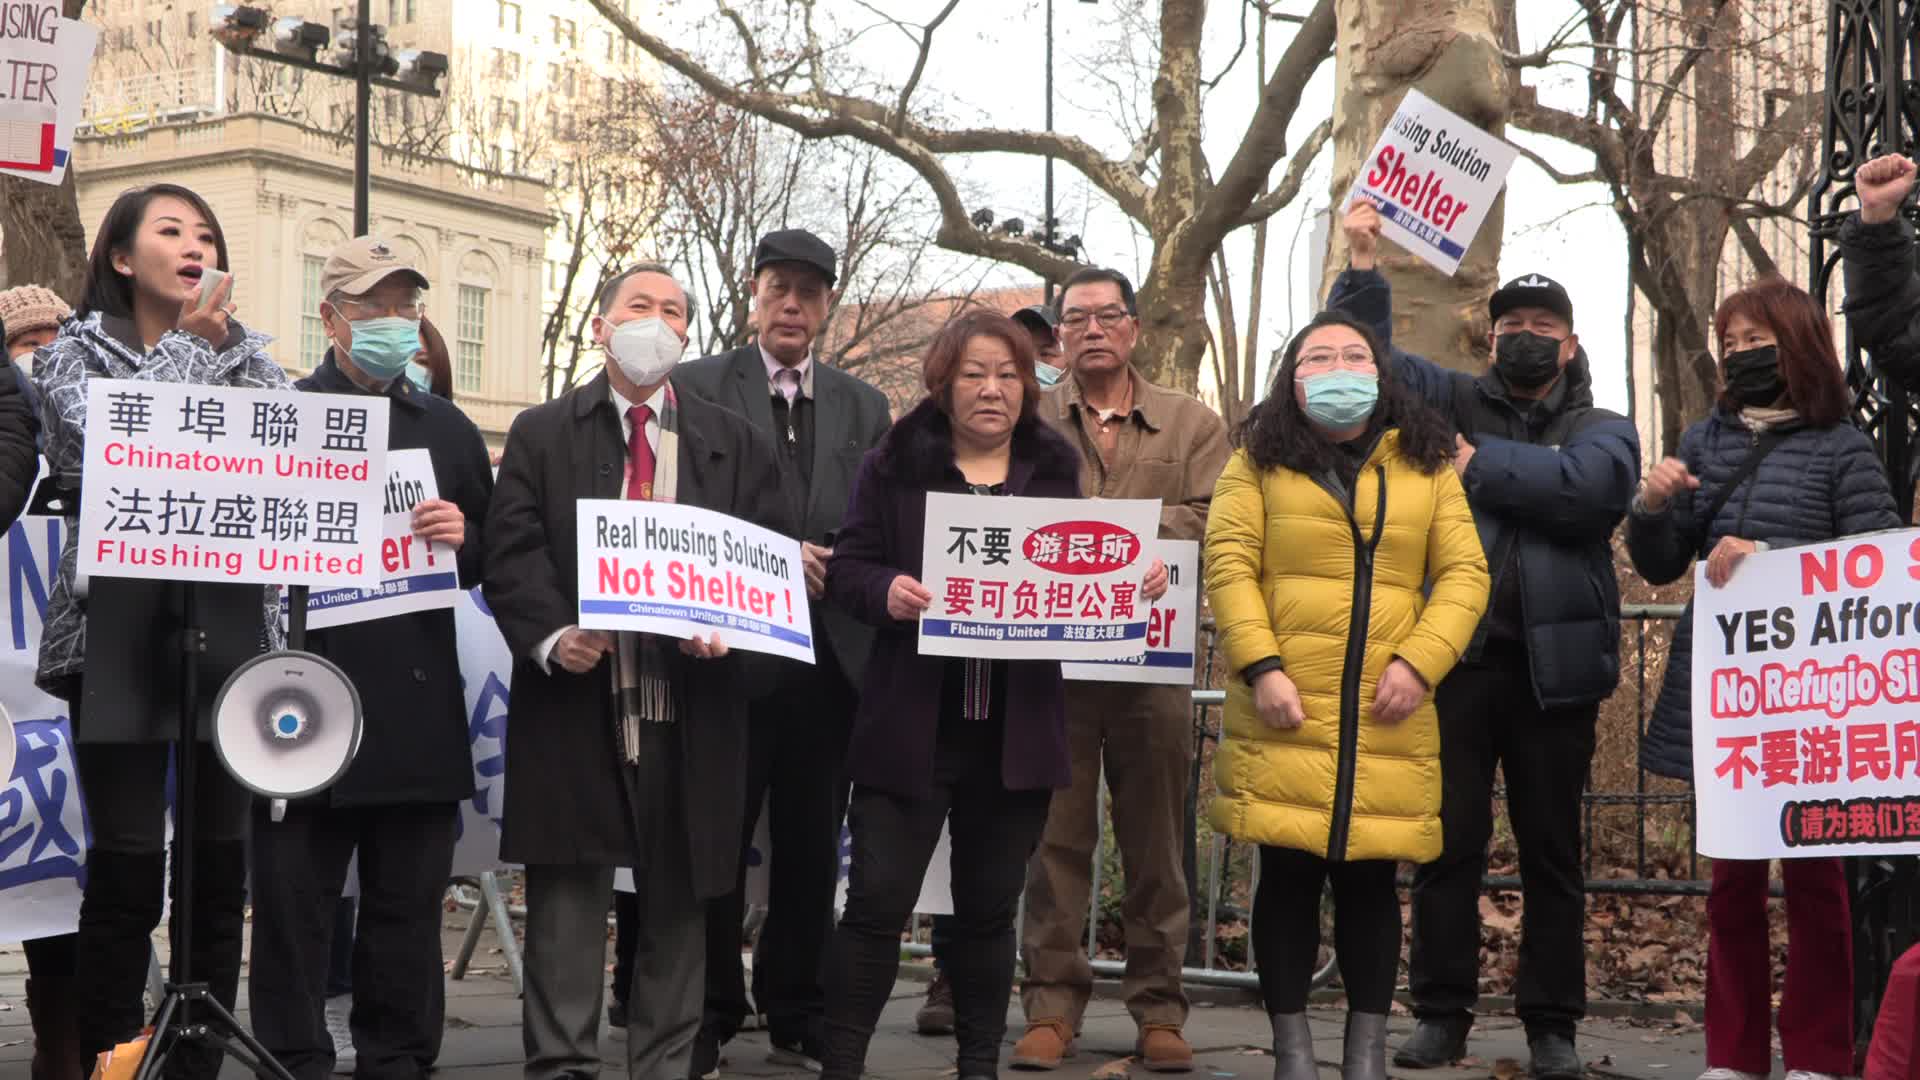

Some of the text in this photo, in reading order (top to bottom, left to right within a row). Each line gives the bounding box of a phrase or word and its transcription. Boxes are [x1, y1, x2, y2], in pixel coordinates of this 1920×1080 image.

[0, 59, 57, 105] TER
[1391, 112, 1491, 182] using Solution
[1367, 144, 1468, 232] Shelter
[108, 391, 368, 451] 華埠聯盟
[104, 442, 369, 481] Chinatown United
[104, 487, 359, 544] 法拉盛聯盟
[97, 540, 363, 575] Flushing United
[597, 515, 789, 580] Real Housing Solution
[947, 526, 1132, 565] 不要 游民所
[1800, 544, 1884, 596] NO
[321, 590, 359, 606] United
[598, 557, 655, 597] Not
[667, 560, 776, 617] Shelter
[944, 577, 1137, 620] 要可负担公寓
[628, 603, 688, 618] Chinatown
[689, 608, 725, 624] United
[951, 622, 1004, 640] Flushing
[1008, 625, 1048, 638] United
[1716, 605, 1796, 656] YES
[1712, 669, 1758, 717] No
[1762, 656, 1878, 717] Refugio
